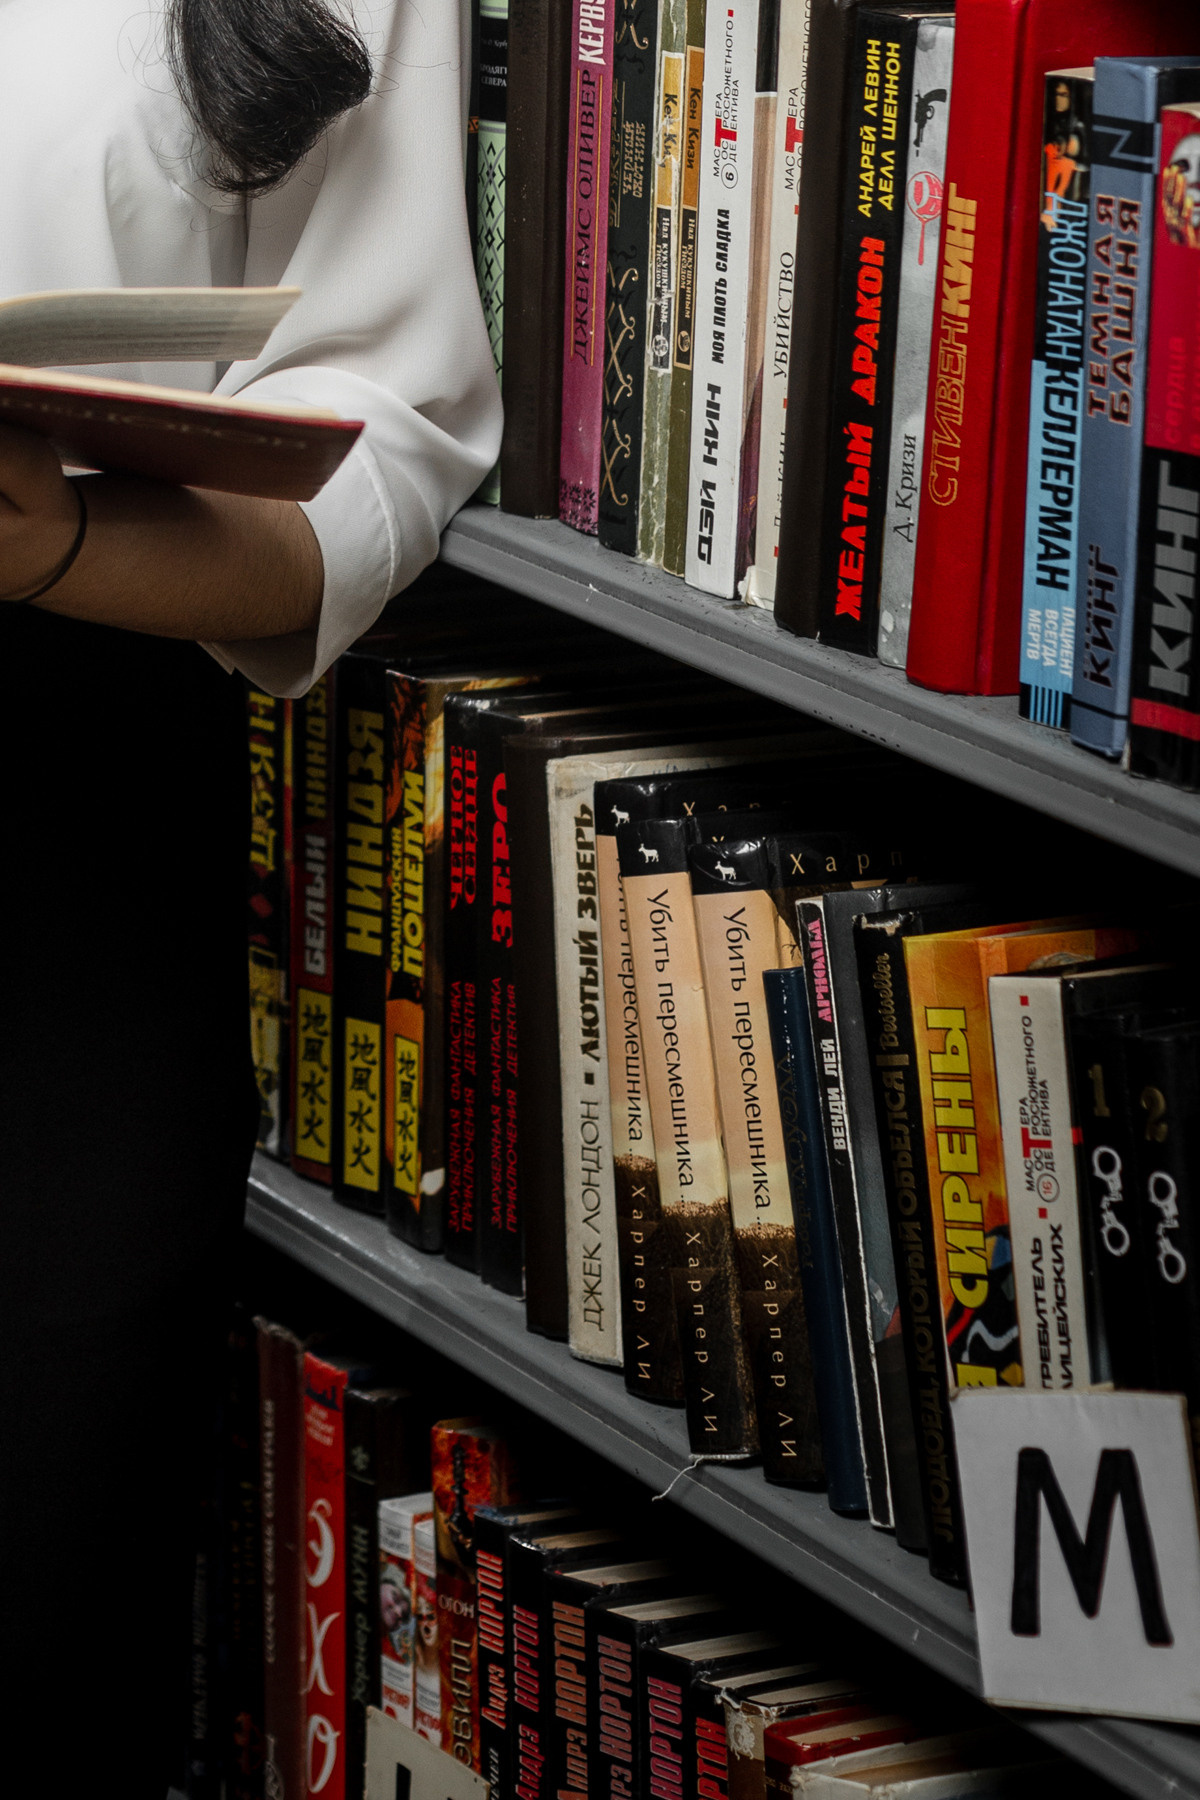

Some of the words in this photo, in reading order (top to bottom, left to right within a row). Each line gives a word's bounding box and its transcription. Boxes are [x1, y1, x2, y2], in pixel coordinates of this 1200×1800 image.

[577, 69, 597, 197] ОЛИВЕР
[690, 87, 702, 120] Кен
[864, 38, 882, 117] ЛЕВИН
[881, 42, 901, 141] ШЕННОН
[687, 125, 701, 170] Кизи
[858, 124, 878, 218] АНДРЕЙ
[877, 150, 896, 212] ДЕЛЛ
[574, 207, 593, 365] ДЖЕЙМС
[679, 245, 689, 290] гнездом
[683, 244, 695, 319] кукушкиным
[687, 218, 696, 240] Над
[715, 208, 730, 271] СЛАДКА
[941, 182, 977, 319] КИНГ
[1044, 192, 1089, 362] ДЖОНАТАН
[711, 330, 726, 365] МОЯ
[713, 272, 728, 328] ПЛОТЬ
[773, 251, 795, 379] УБИЙСТВО
[850, 236, 885, 406] ДРАКОН
[1088, 194, 1115, 417] ТЕМНАЯ
[1108, 198, 1141, 426] БАШНЯ
[896, 433, 918, 511] Кризи
[928, 315, 968, 507] СТИВЕН
[835, 421, 874, 621] ЖЕЛТЫЙ
[893, 513, 915, 544] Д.
[1036, 361, 1085, 592] КЕЛЛЕРМАН
[1027, 608, 1042, 660] МЕРТВ
[1042, 609, 1060, 668] ВСЕГДА
[1085, 544, 1122, 689] КИНГ
[1148, 459, 1200, 697] КИНГ
[1058, 605, 1076, 679] ПАЦИЕНТ
[345, 705, 385, 958] НИНДЗЯ
[402, 769, 425, 978] ПОЦЕЛУЙ
[574, 802, 597, 922] ЗВЕРЬ
[646, 888, 673, 974] Убить
[722, 906, 751, 992] Убить
[450, 980, 462, 1100] ФАНТАСТИКА
[464, 982, 477, 1076] ДЕТЕКТИВ
[490, 977, 502, 1097] ФАНТАСТИКА
[506, 983, 518, 1077] ДЕТЕКТИВ
[572, 931, 601, 1063] ЛЮТЫЙ
[819, 1037, 836, 1078] ЛЕЙ
[656, 981, 694, 1187] пересмешника
[733, 1001, 772, 1209] пересмешника
[826, 1086, 848, 1151] ВЕНДИ
[1087, 1063, 1112, 1118] 1
[1140, 1085, 1169, 1143] 2
[448, 1108, 461, 1233] ЗАРУБЕЖНАЯ
[462, 1087, 475, 1232] ПРИКЛЮЧЕНИЯ
[490, 1103, 502, 1229] ЗАРУБЕЖНАЯ
[505, 1089, 518, 1233] ПРИКЛЮЧЕНИЯ
[579, 1099, 602, 1234] ЛОНДОН
[925, 1006, 990, 1308] СИРЕНЫ
[582, 1242, 605, 1332] ДЖЕК
[631, 1185, 647, 1313] Харпер
[686, 1232, 710, 1364] Харпер
[761, 1254, 787, 1388] Харпер
[475, 1549, 506, 1655] НОРТОН
[1011, 1446, 1174, 1649] М
[512, 1604, 540, 1713] НОРТОН
[552, 1600, 588, 1727] НОРТОН
[597, 1634, 634, 1764] НОРТОН
[647, 1675, 684, 1800] НОРТОН
